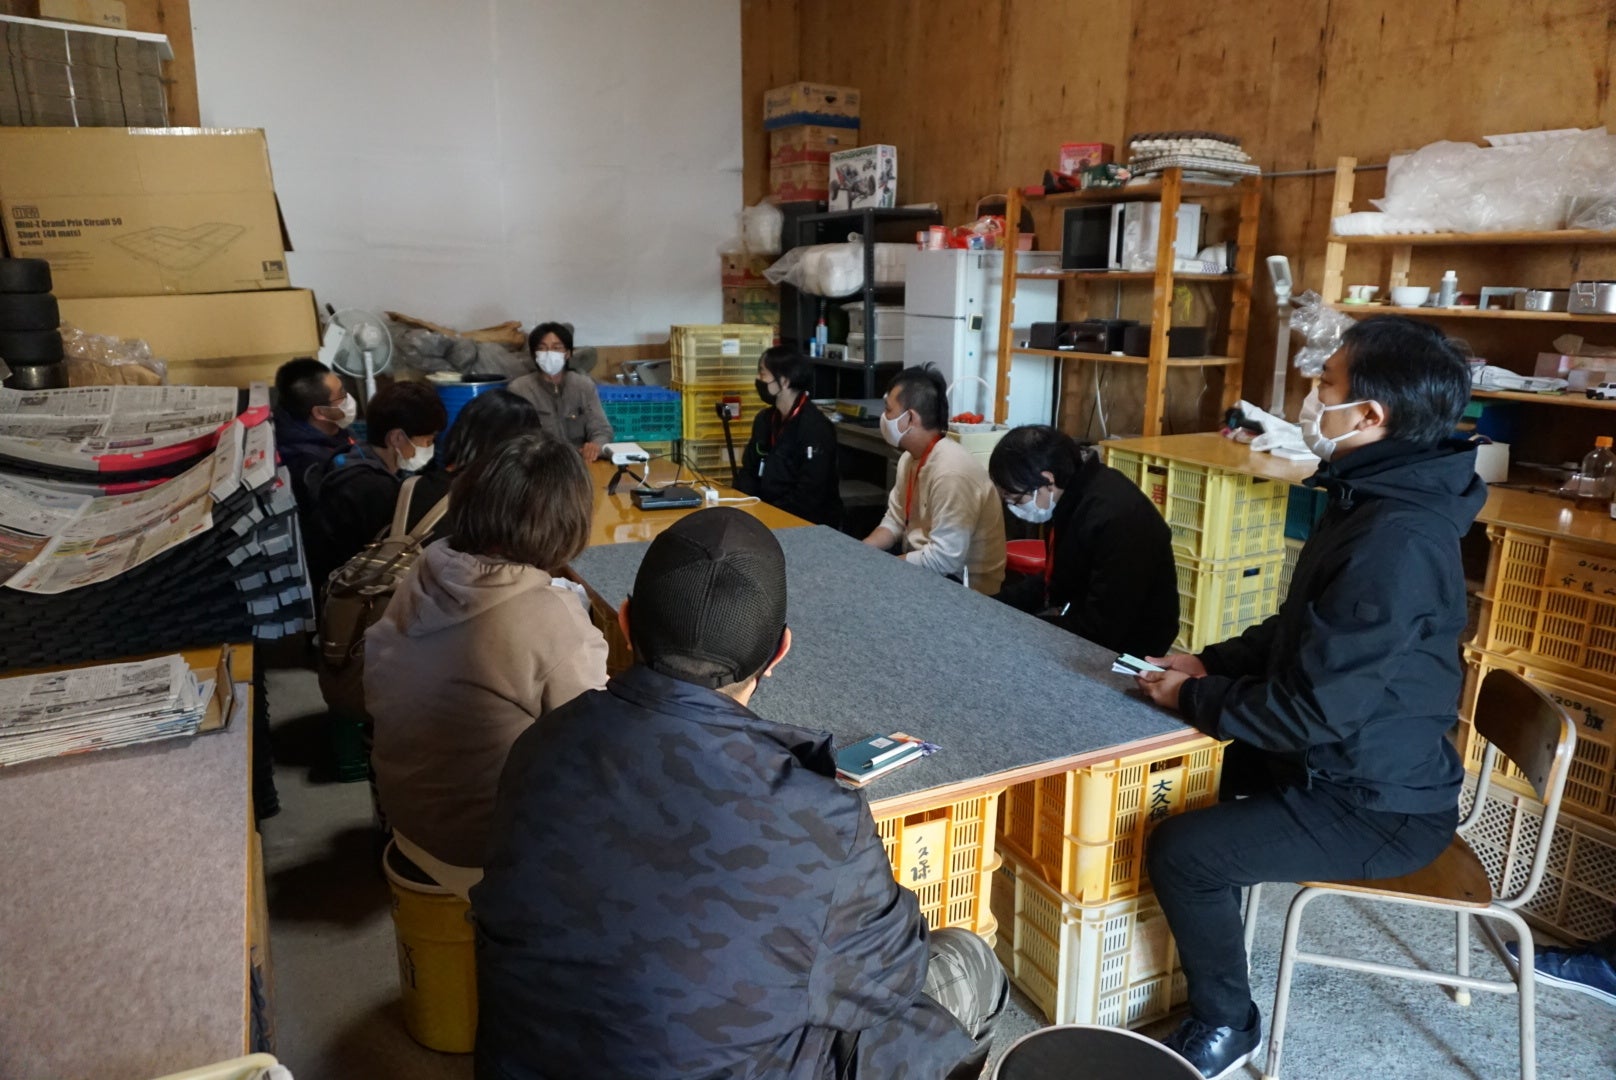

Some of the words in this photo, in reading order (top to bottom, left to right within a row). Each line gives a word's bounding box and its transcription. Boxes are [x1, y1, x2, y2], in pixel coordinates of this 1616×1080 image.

[42, 219, 66, 228] Grand
[67, 218, 83, 227] Prix
[84, 218, 110, 226] Circuit
[112, 218, 122, 226] 50
[17, 231, 40, 239] Short
